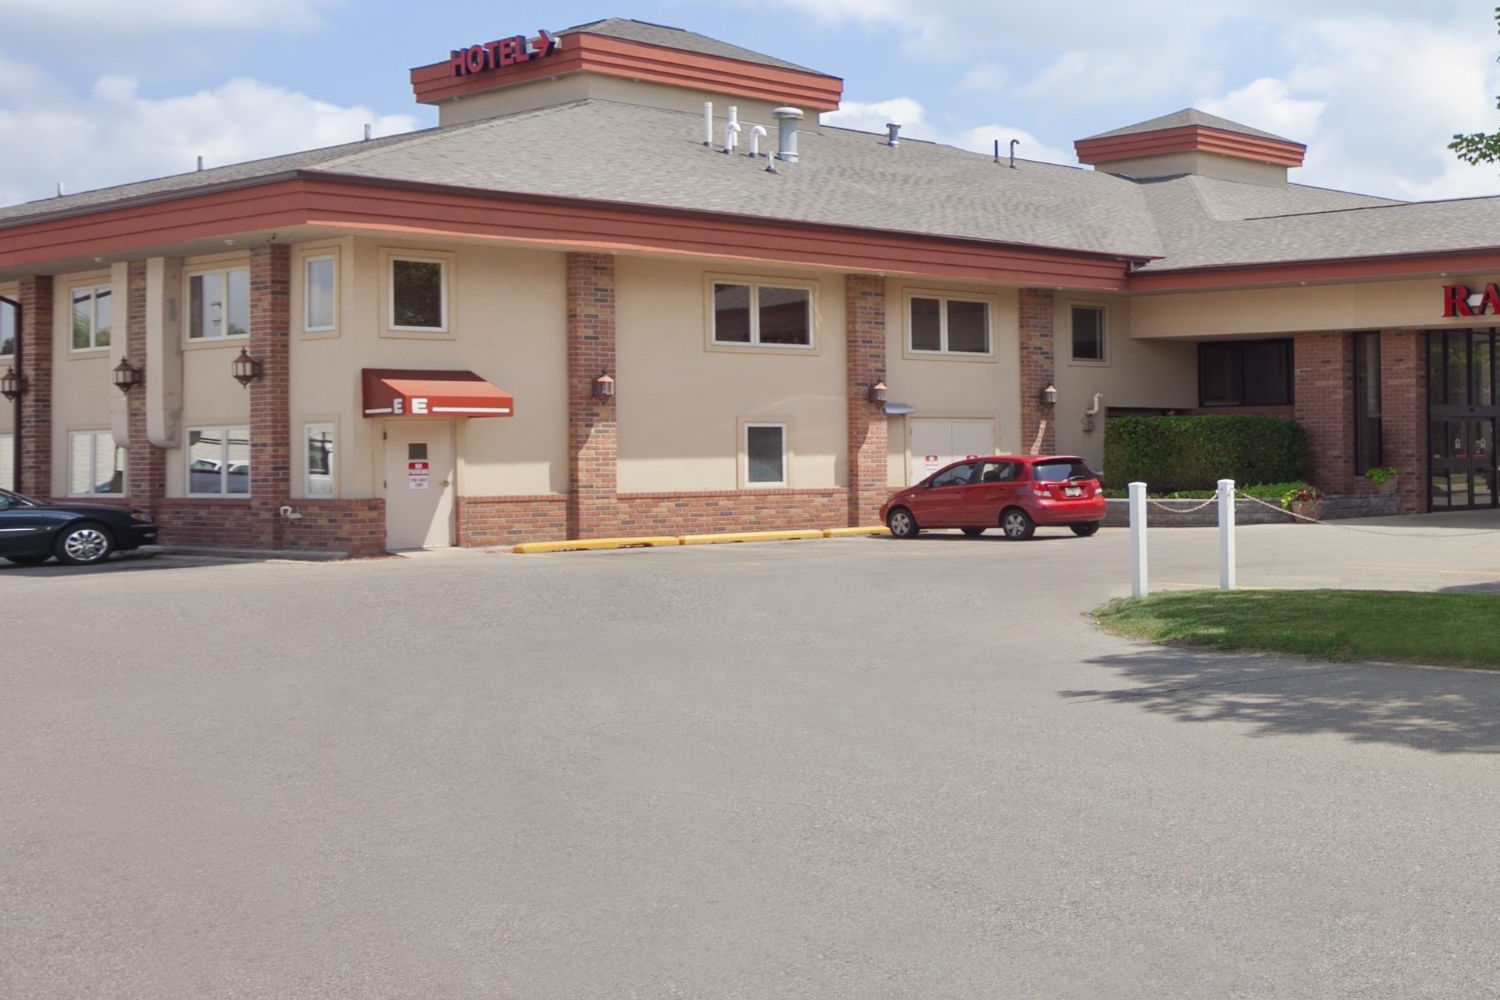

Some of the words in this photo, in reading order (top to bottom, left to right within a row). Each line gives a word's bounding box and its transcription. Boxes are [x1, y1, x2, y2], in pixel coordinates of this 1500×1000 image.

[450, 34, 529, 78] HOTEL
[393, 397, 403, 414] E
[411, 397, 428, 414] E
